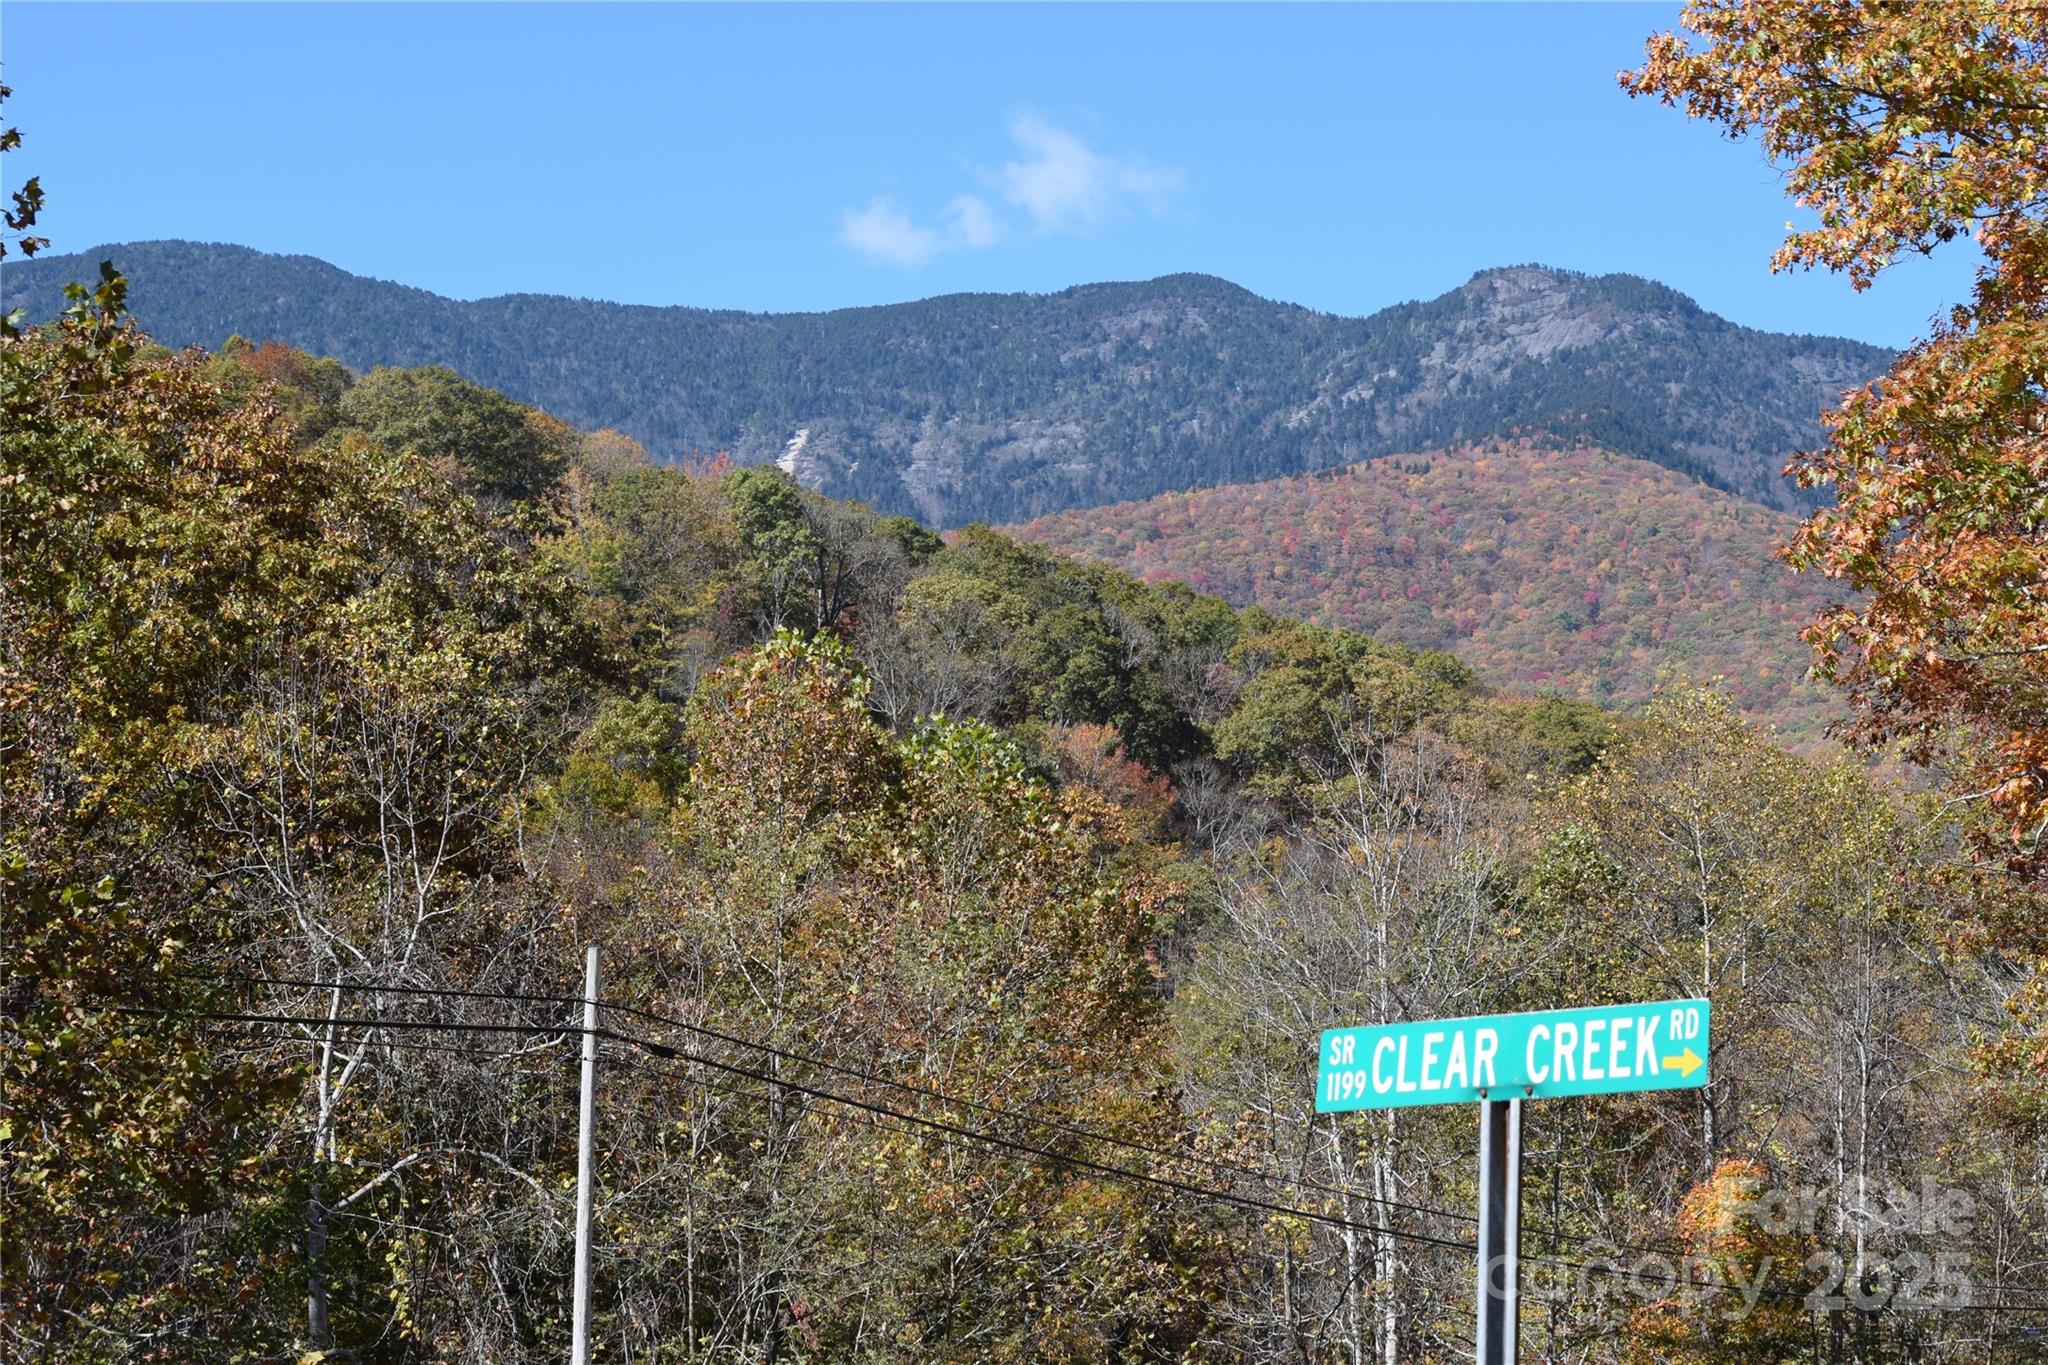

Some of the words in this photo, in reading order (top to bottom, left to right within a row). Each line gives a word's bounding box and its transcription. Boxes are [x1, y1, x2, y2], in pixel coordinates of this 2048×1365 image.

[1669, 1007, 1700, 1041] RD
[1329, 1036, 1355, 1065] SR
[1371, 1027, 1499, 1094] CLEAR
[1525, 1014, 1662, 1084] CREEK
[1327, 1070, 1366, 1102] 1199
